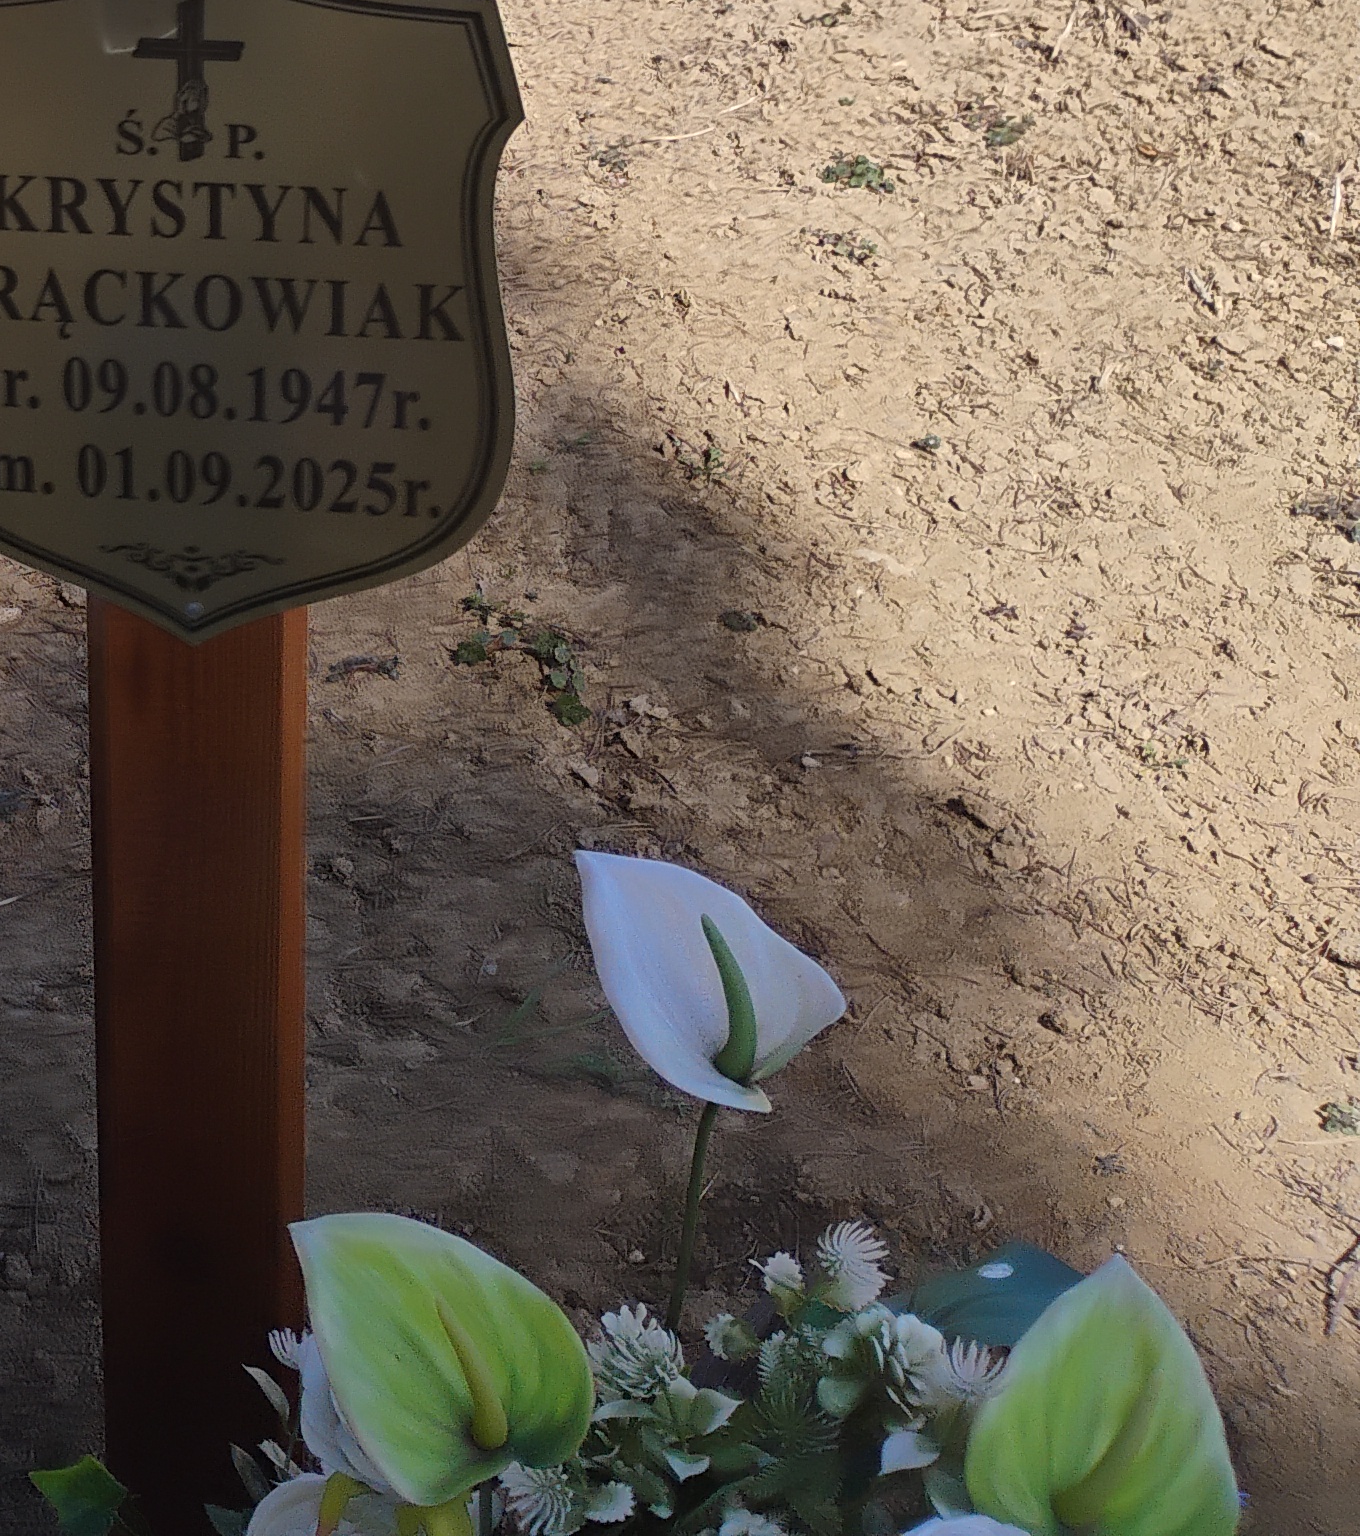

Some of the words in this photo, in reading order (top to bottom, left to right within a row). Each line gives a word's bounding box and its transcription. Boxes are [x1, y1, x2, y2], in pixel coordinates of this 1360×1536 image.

[115, 109, 158, 156] Ś.
[224, 123, 266, 161] P.
[62, 356, 433, 432] 09.08.1947r.
[77, 443, 444, 519] 01.09.2025r.
